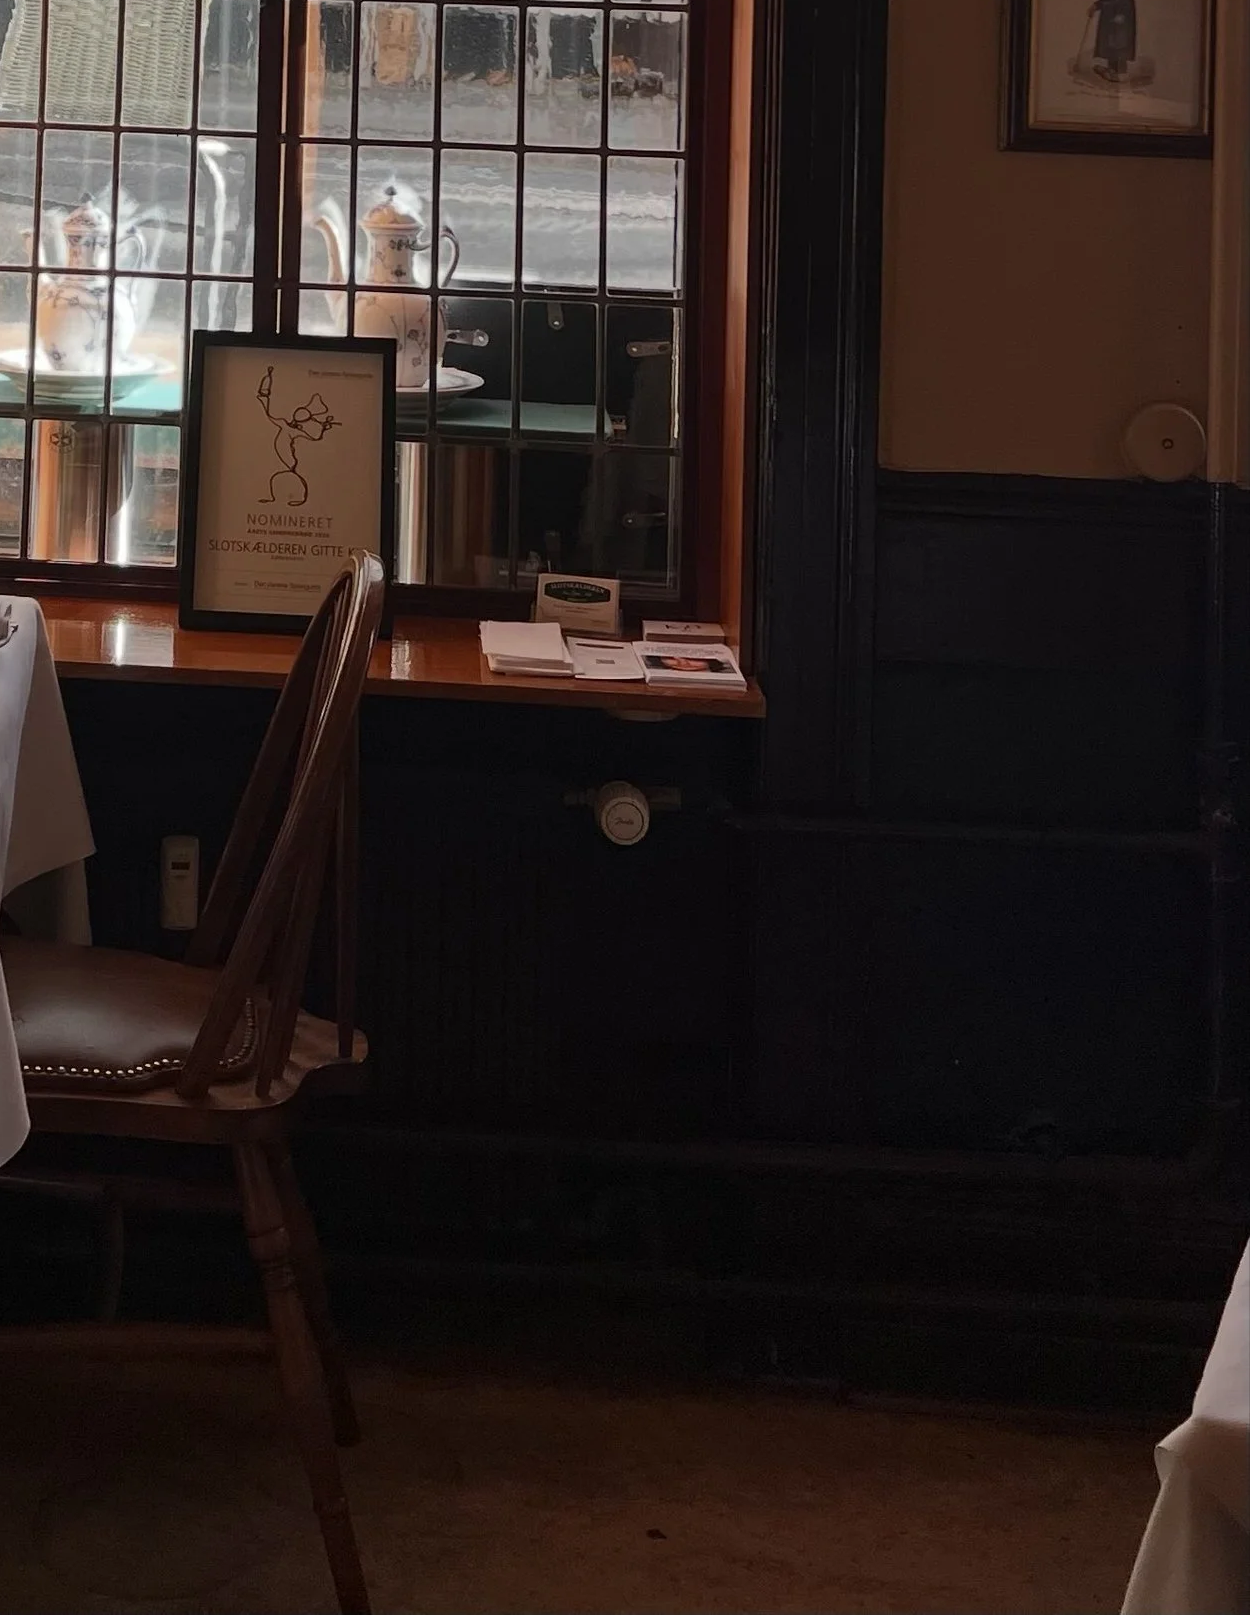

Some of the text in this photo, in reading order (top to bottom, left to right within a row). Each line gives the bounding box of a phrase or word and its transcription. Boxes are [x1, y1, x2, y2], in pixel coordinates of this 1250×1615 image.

[247, 513, 333, 530] NOMINERET
[208, 539, 306, 556] SLOTSKÆLDEREN
[311, 545, 343, 557] GITTE
